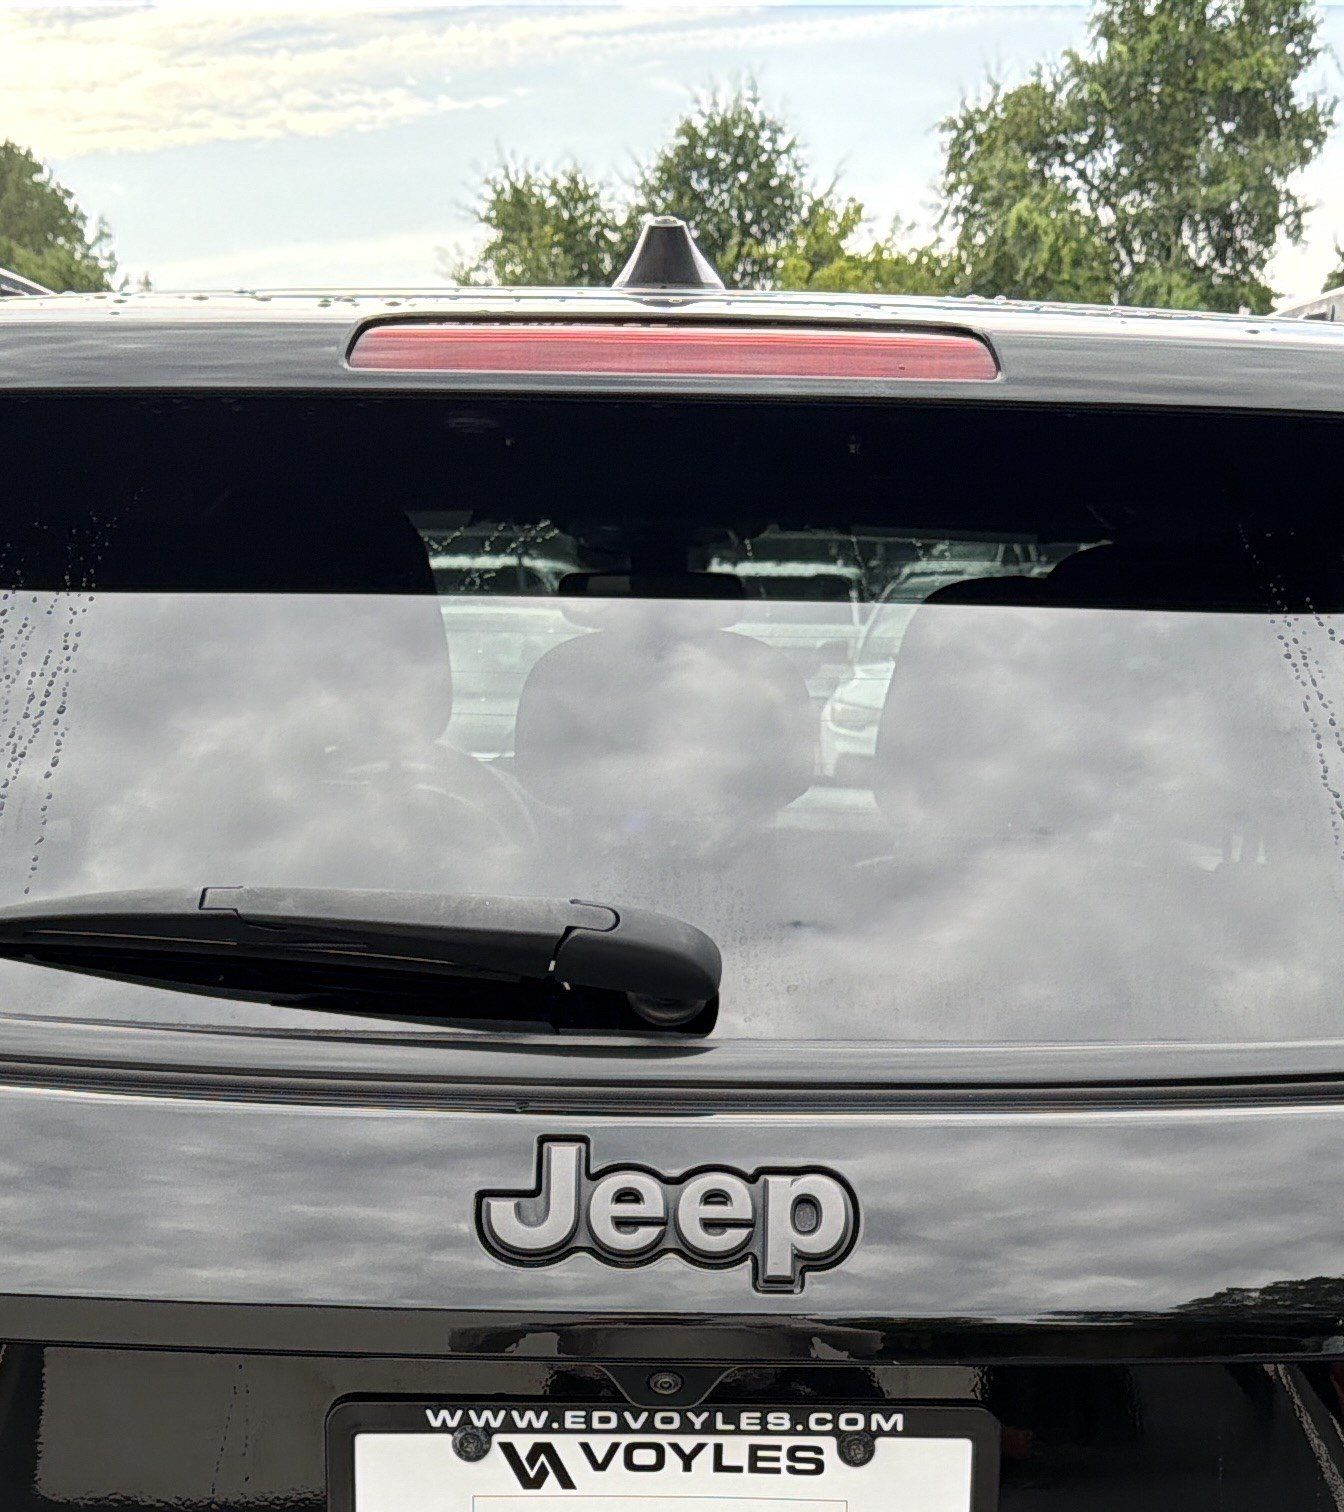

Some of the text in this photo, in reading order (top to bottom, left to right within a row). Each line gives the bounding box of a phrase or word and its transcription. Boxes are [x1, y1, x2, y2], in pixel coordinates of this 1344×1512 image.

[480, 1138, 856, 1288] Jeep
[425, 1408, 905, 1432] WWW.EDVOYLES.COM
[576, 1441, 825, 1476] VOYLES
